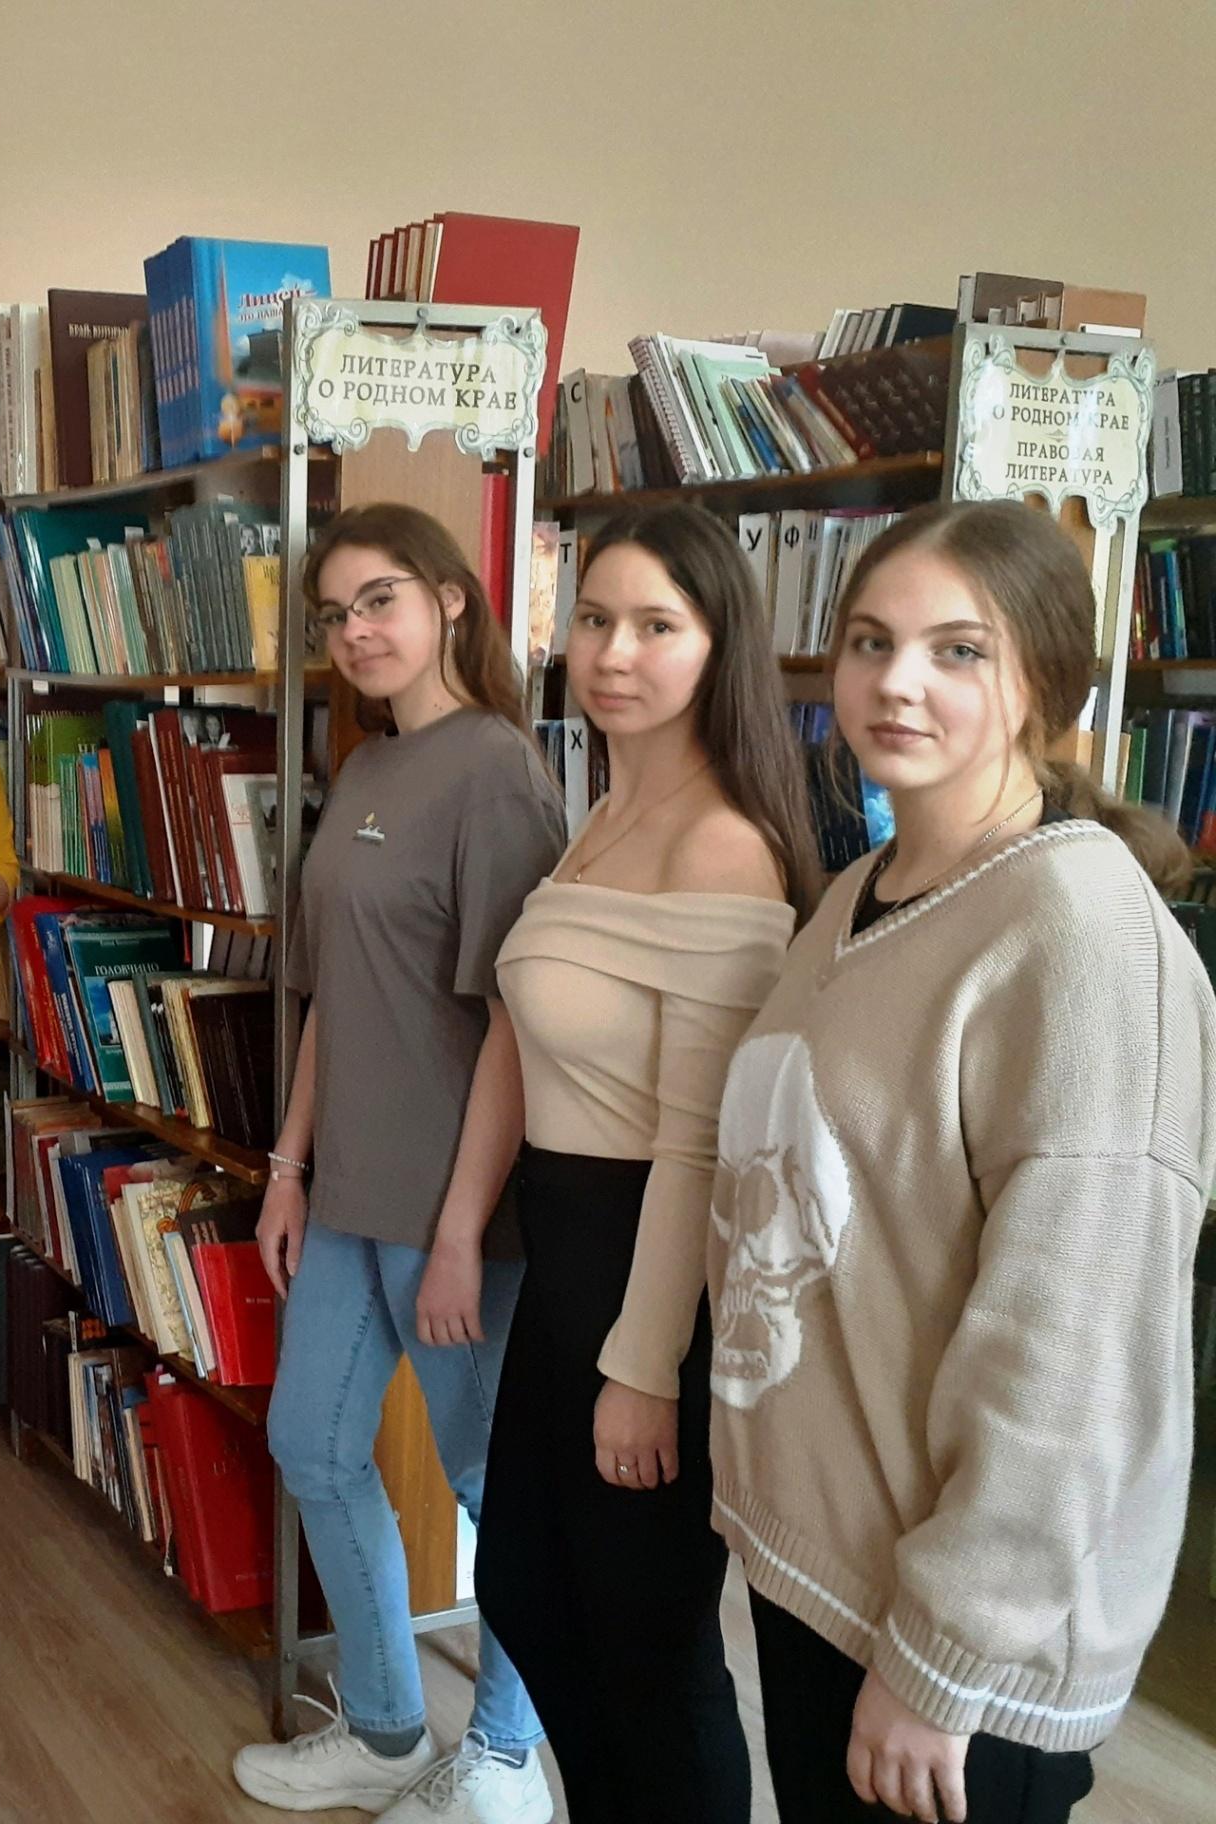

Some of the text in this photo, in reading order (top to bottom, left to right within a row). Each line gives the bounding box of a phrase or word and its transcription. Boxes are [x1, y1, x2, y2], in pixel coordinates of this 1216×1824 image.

[340, 354, 497, 385] ЛИТЕРАТУРА
[318, 378, 517, 410] О РОДНОМ КРАЕ
[992, 404, 1006, 421] О
[1011, 405, 1080, 427] РОДНОМ
[1005, 462, 1114, 486] ЛИТЕРАТУРА
[784, 524, 800, 549] Ф
